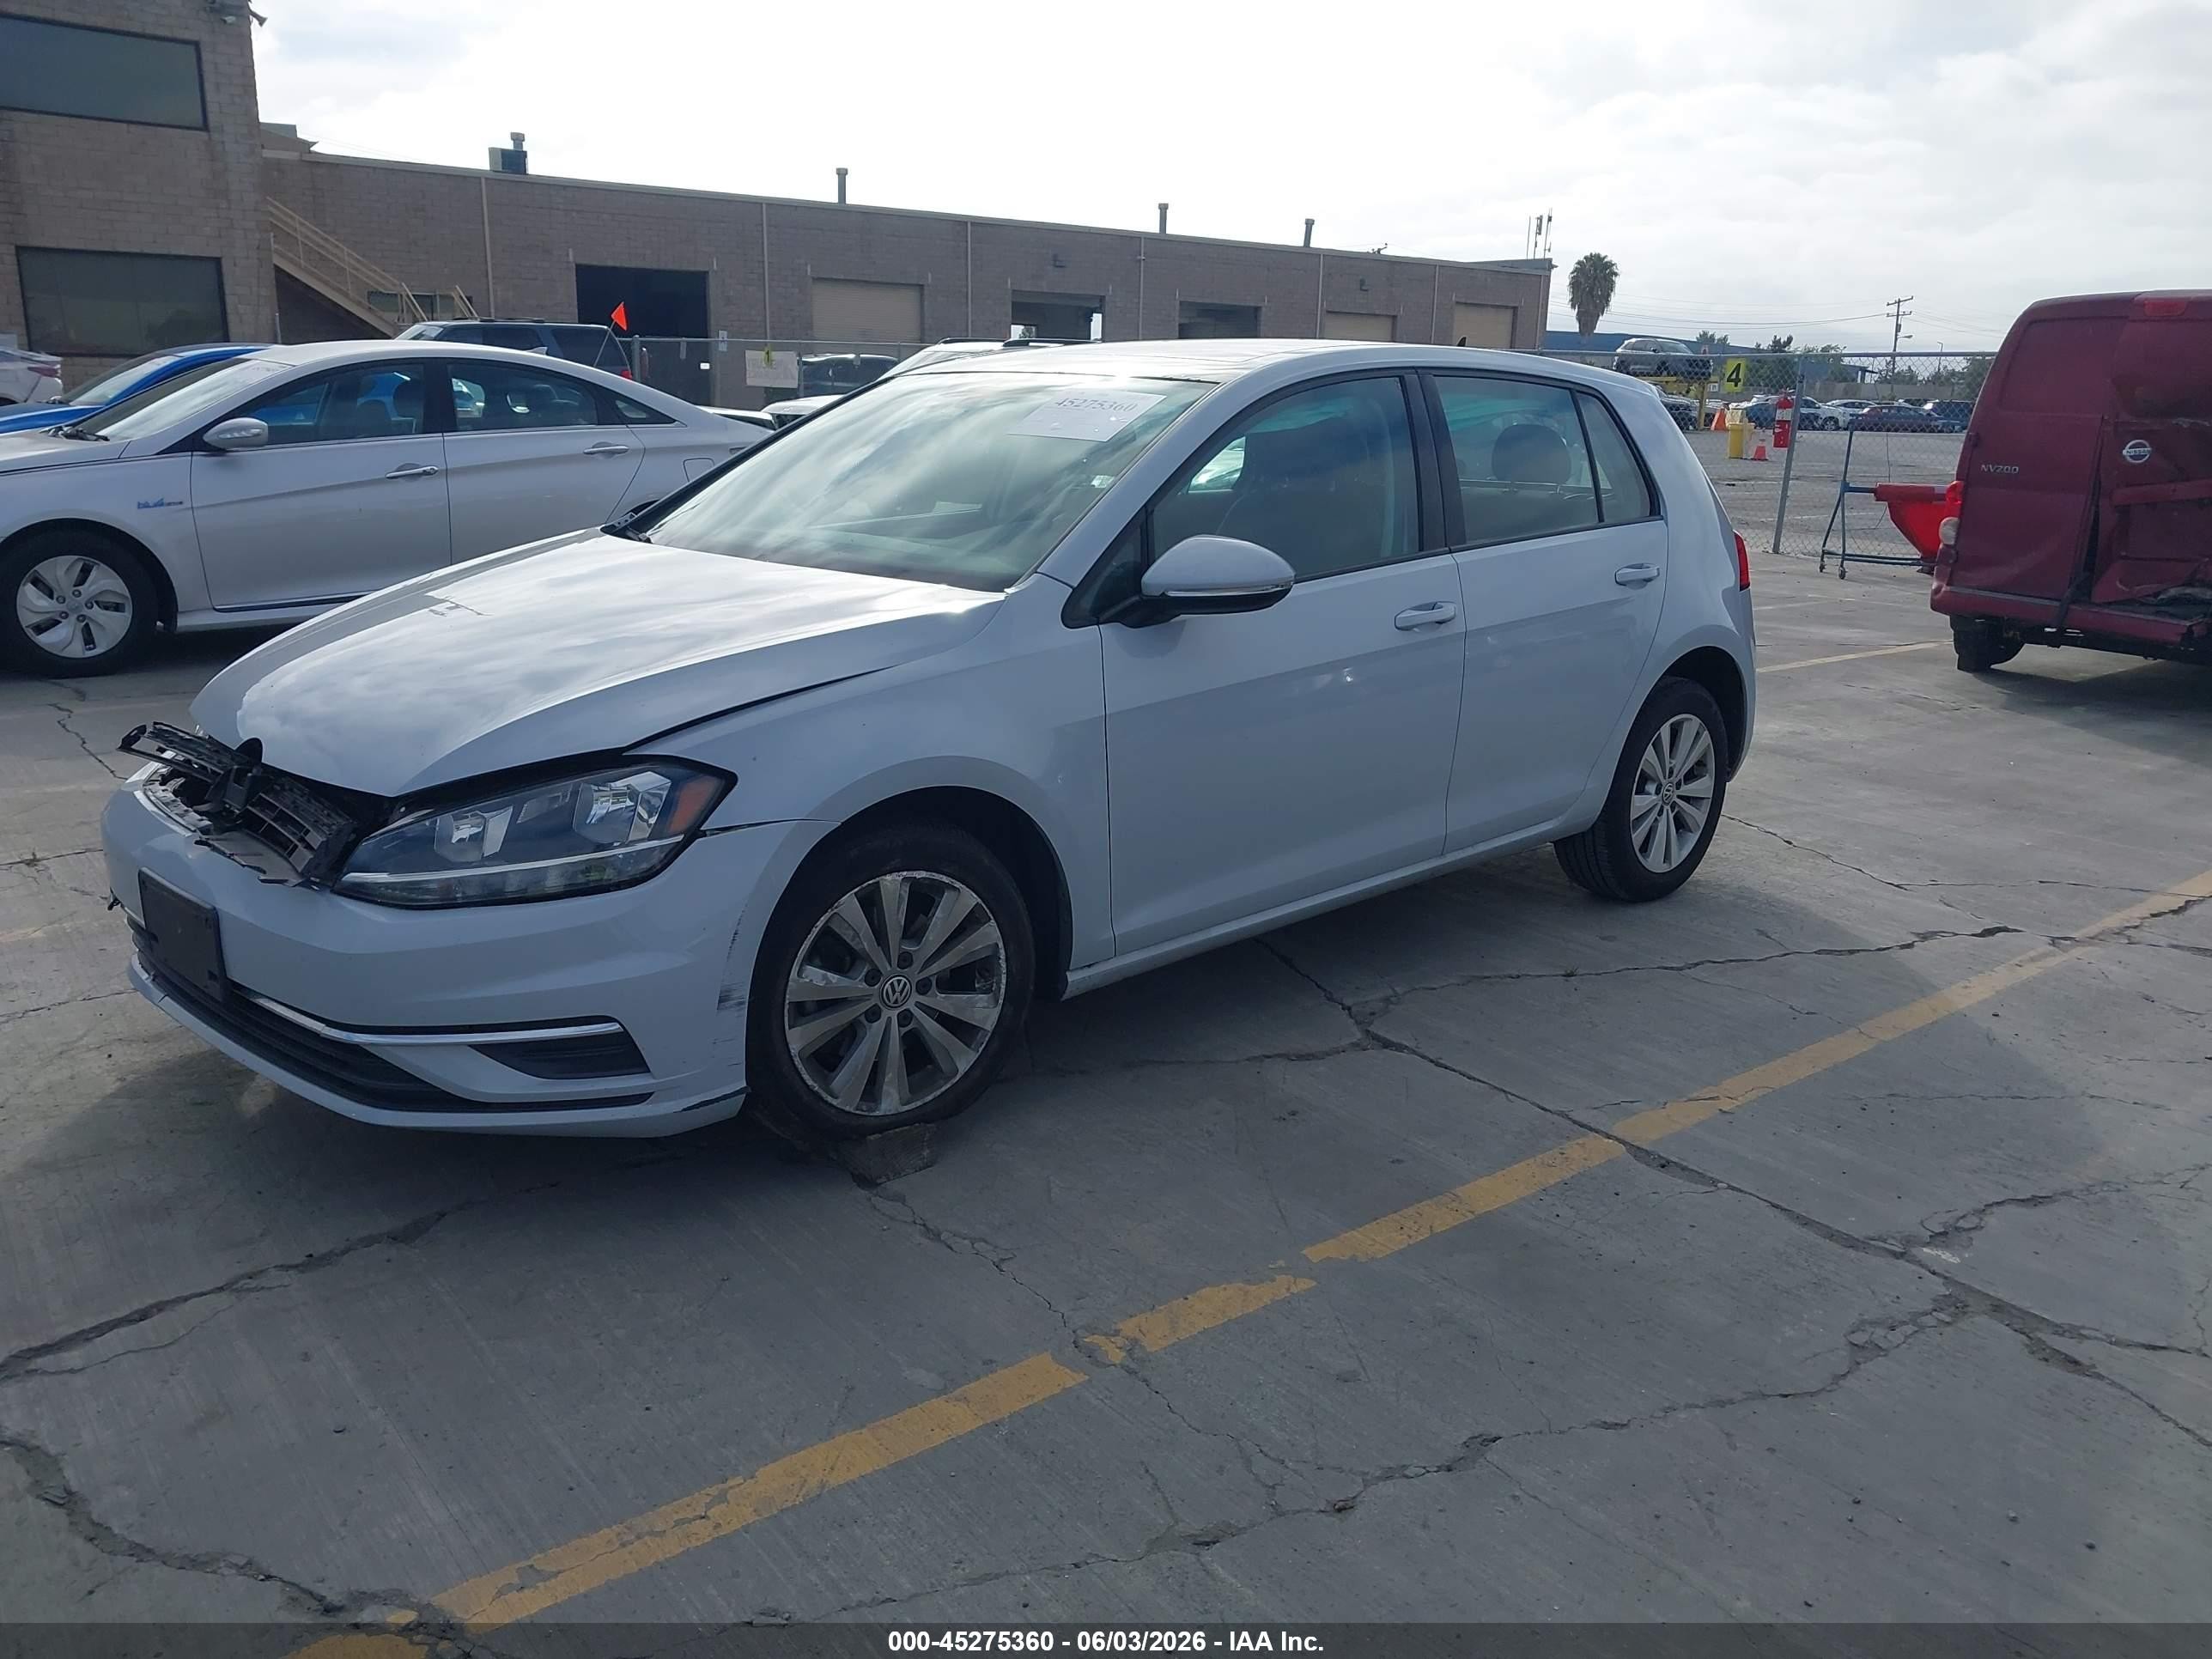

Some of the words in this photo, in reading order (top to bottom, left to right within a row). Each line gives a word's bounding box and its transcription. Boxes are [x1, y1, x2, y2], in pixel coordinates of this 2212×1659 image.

[1726, 362, 1742, 387] 4
[1054, 398, 1138, 411] 45275360
[1980, 464, 2019, 473] NV200
[884, 976, 911, 1006] VW
